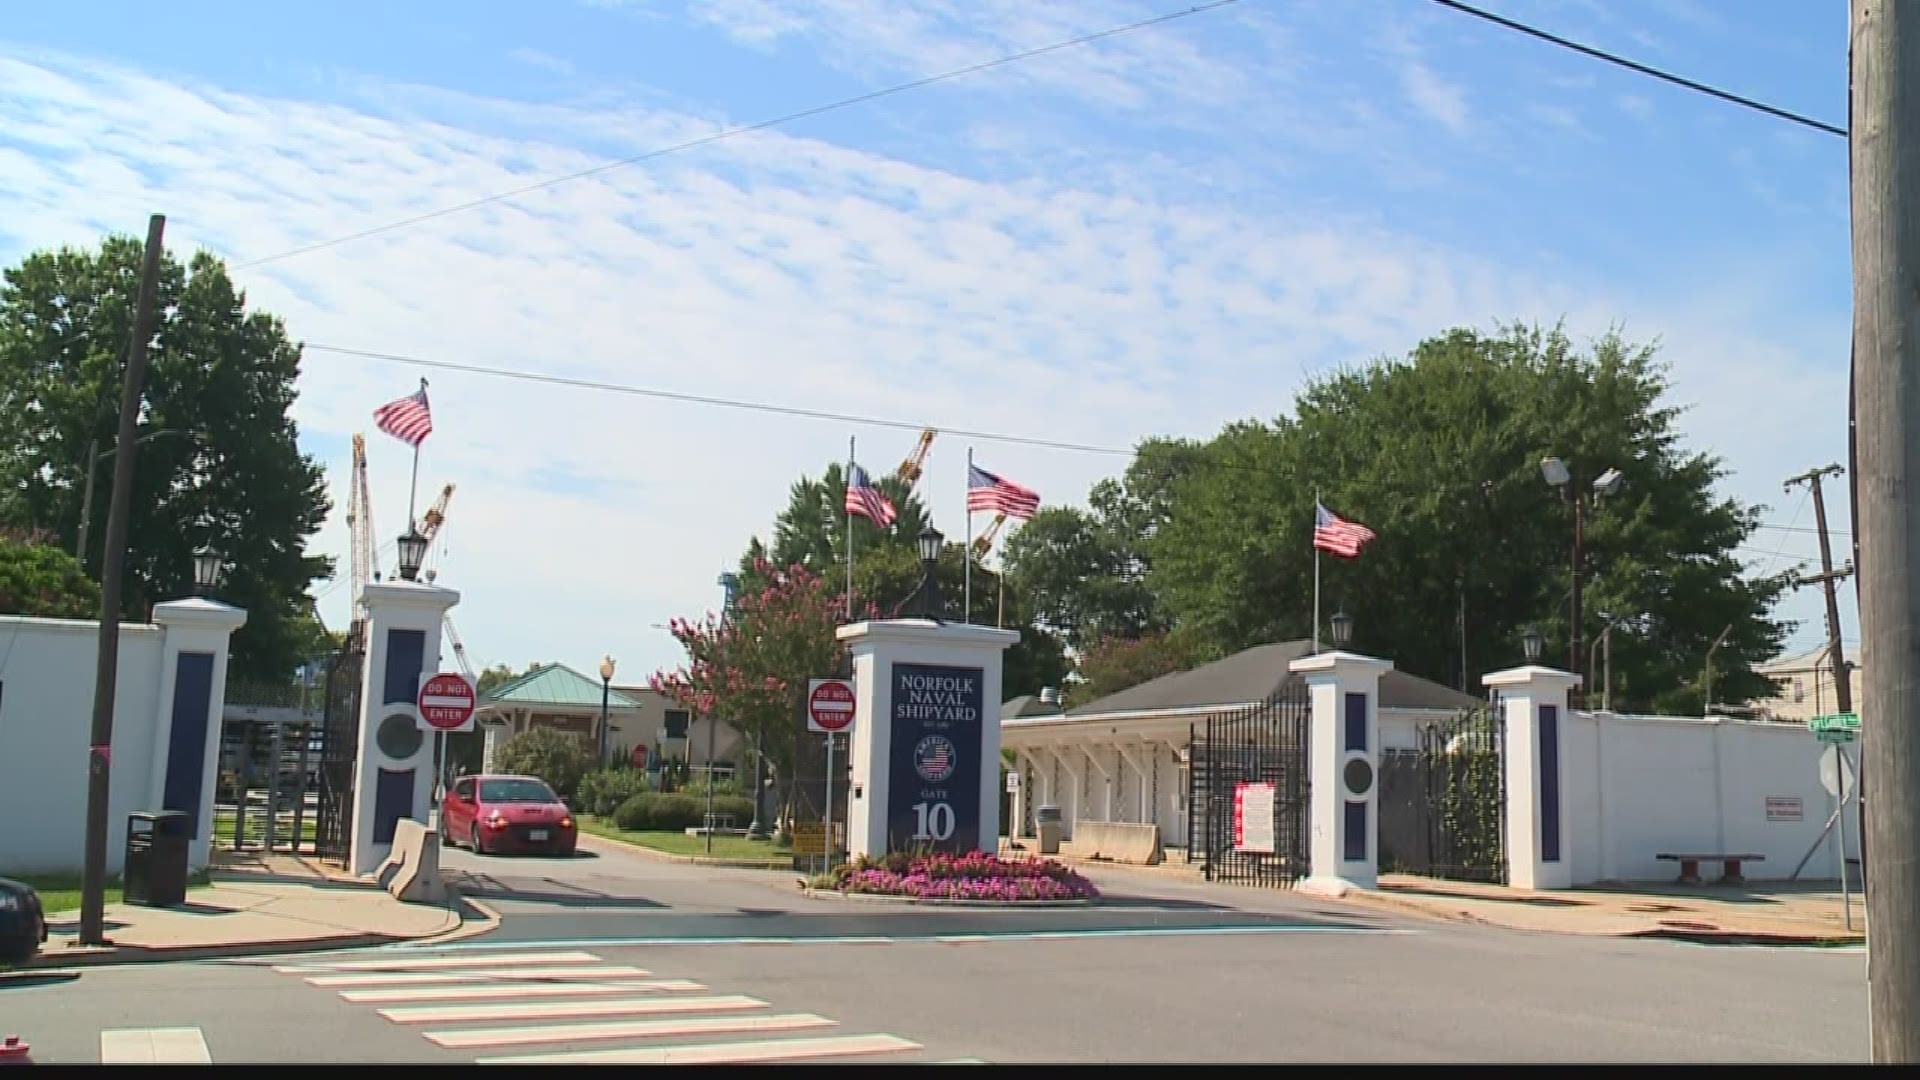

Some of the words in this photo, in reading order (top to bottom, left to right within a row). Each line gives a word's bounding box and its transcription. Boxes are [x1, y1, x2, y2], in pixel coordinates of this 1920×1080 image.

[428, 683, 442, 693] DO
[447, 684, 468, 695] NOT
[900, 674, 974, 693] NORFOLK
[816, 689, 829, 698] DO
[833, 690, 849, 699] NOT
[909, 691, 966, 706] NAVAL
[430, 708, 463, 720] ENTER
[818, 712, 845, 722] ENTER
[897, 705, 976, 721] SHIPYARD
[920, 789, 949, 799] GATE
[911, 802, 956, 841] 10
